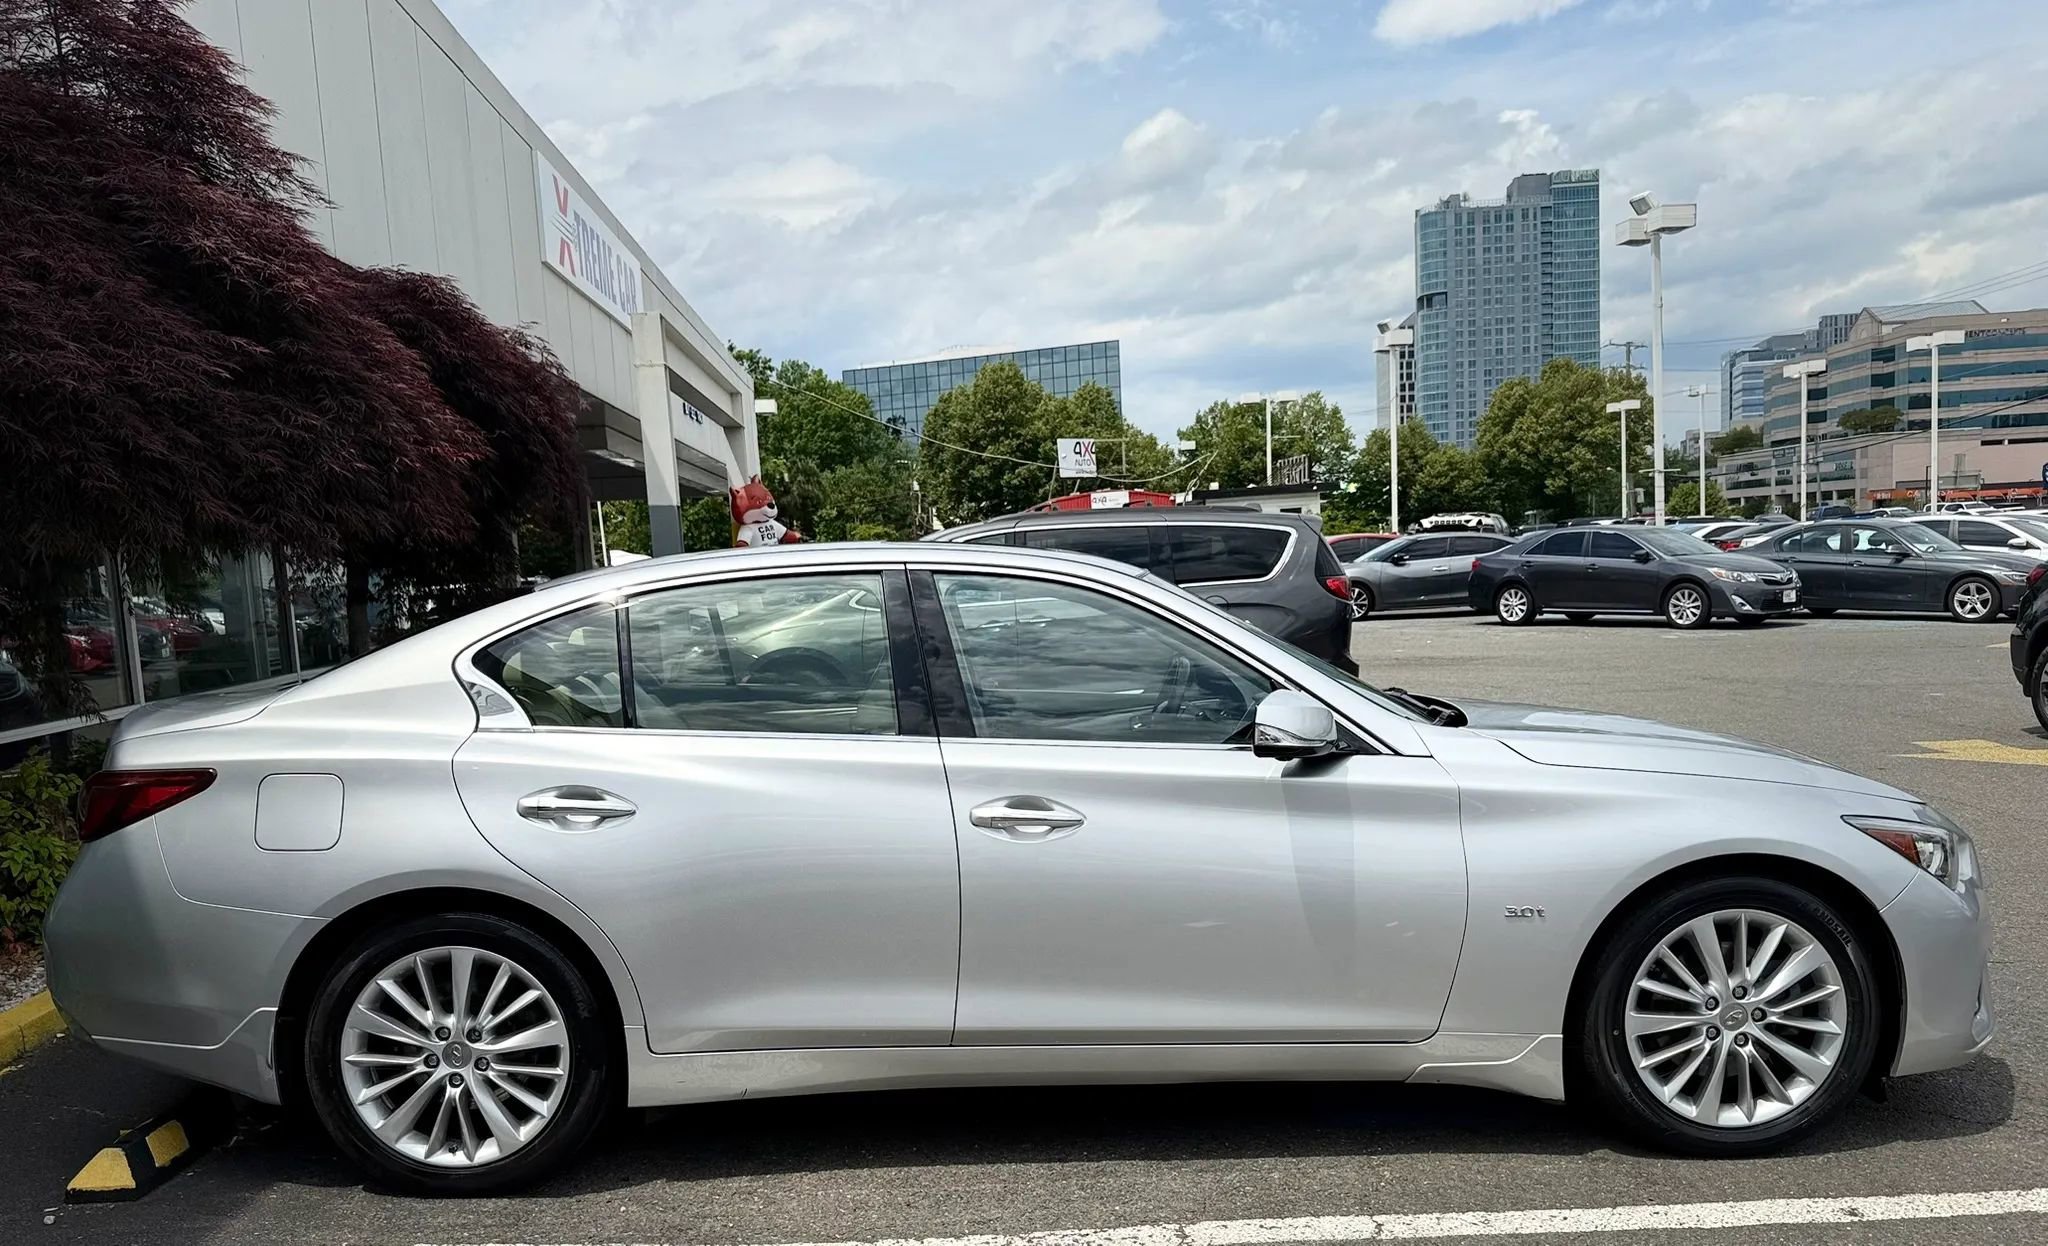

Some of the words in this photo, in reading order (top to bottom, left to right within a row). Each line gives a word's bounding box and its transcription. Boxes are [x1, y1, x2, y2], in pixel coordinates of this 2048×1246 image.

[616, 254, 637, 314] CAR
[758, 525, 774, 533] CAR
[1504, 905, 1545, 918] 3.0t
